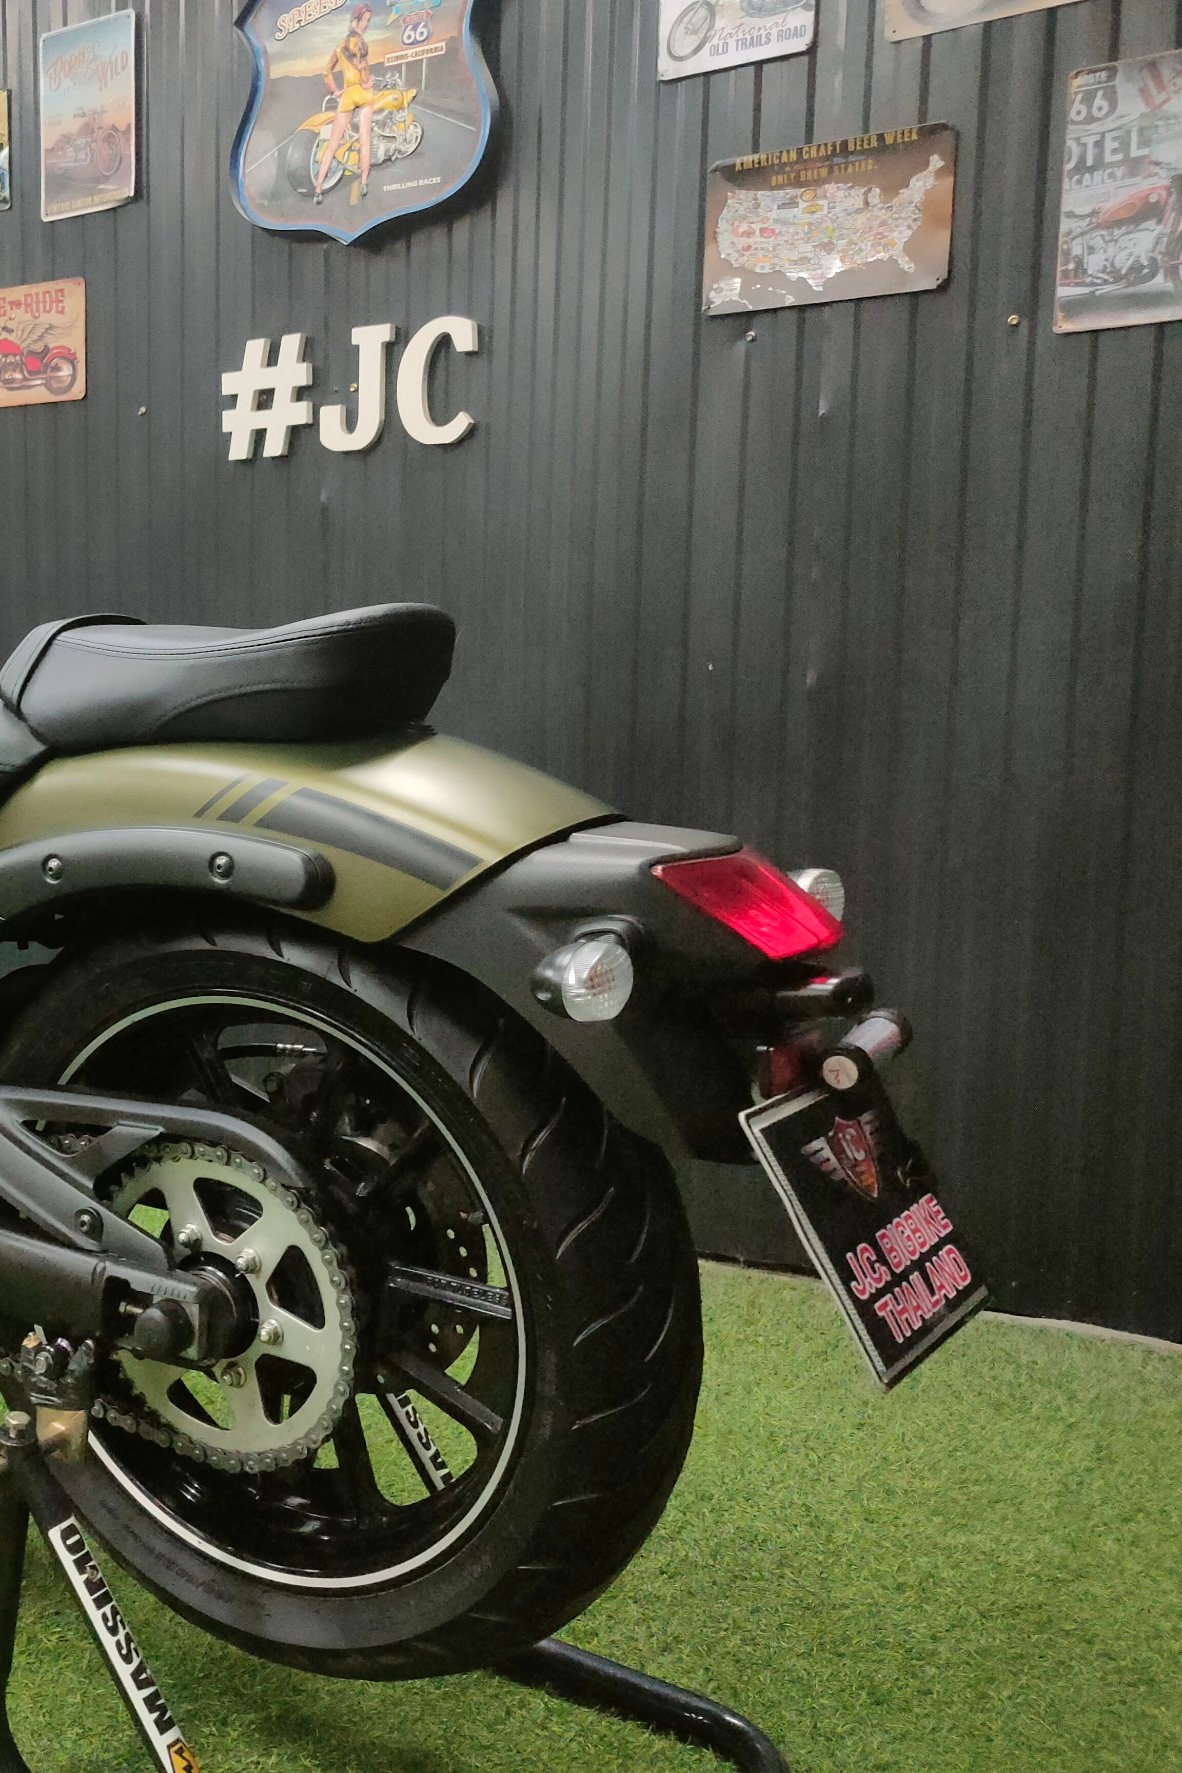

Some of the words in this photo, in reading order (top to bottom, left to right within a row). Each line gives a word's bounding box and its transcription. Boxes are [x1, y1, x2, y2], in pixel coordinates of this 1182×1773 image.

[403, 22, 428, 44] 66
[706, 9, 791, 43] National
[710, 41, 729, 57] OLD
[735, 32, 771, 52] TRAILS
[777, 25, 807, 43] ROAD
[1070, 90, 1109, 121] 66
[735, 150, 797, 171] AMERICAN
[803, 141, 842, 159] CRAFT
[848, 134, 878, 152] BEER
[884, 128, 919, 145] WEEK
[383, 180, 418, 192] THRILLING
[419, 176, 442, 186] RACES
[24, 288, 66, 320] RIDE
[221, 316, 479, 461] #JC
[876, 1192, 954, 1274] BIGBIKE
[874, 1244, 972, 1344] THAILAND
[60, 1522, 177, 1737] MASSIMO
